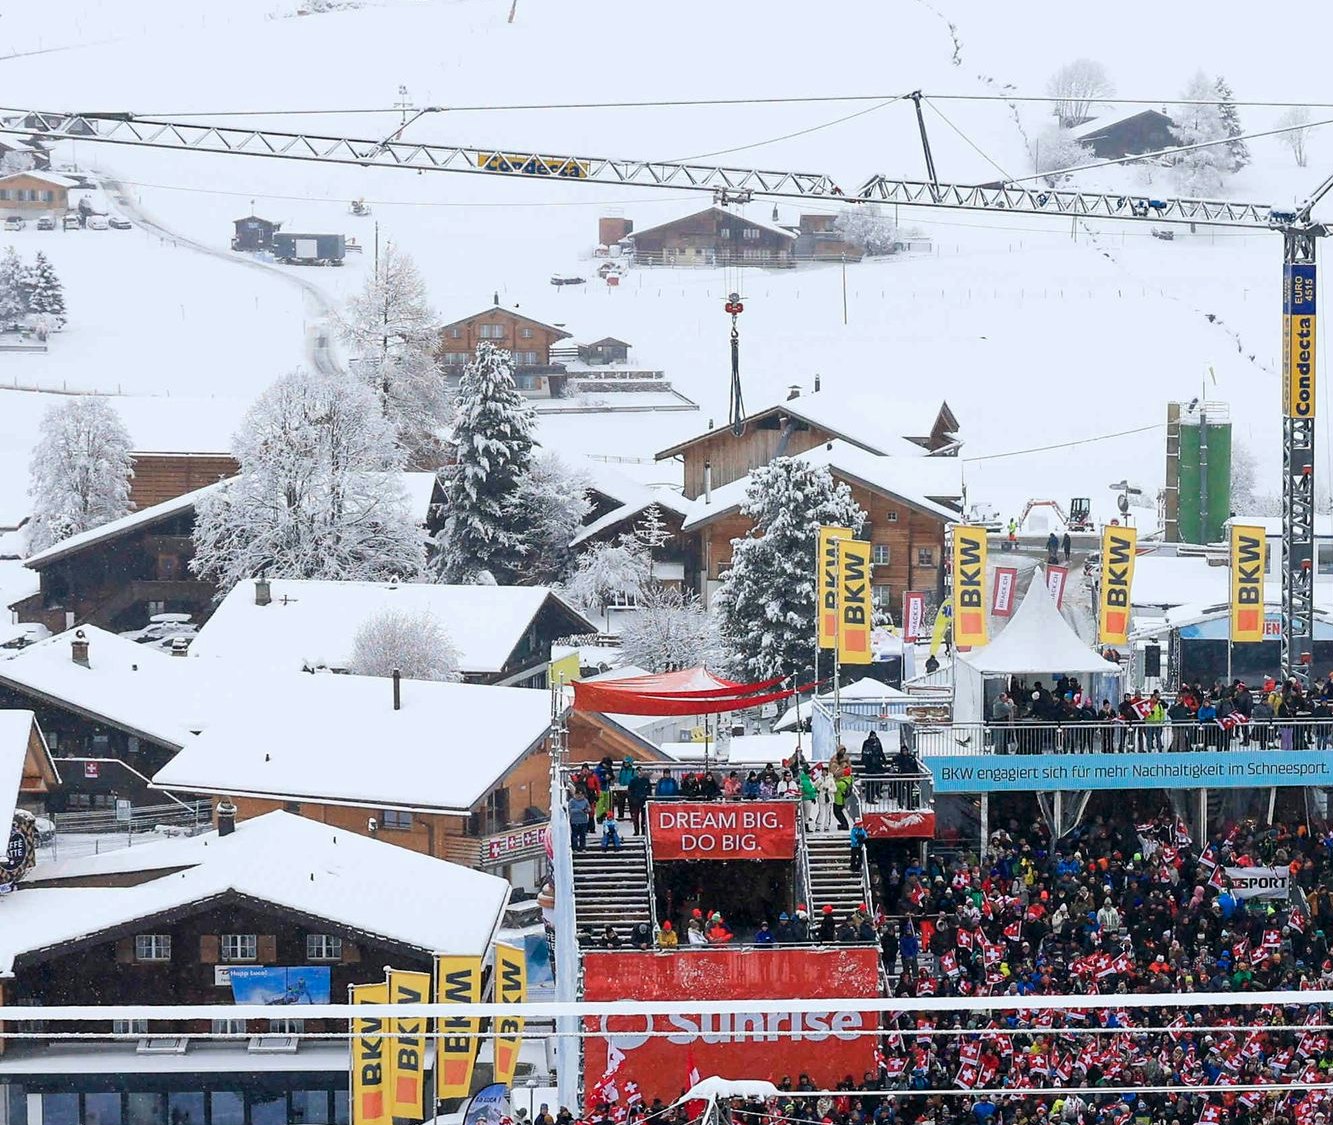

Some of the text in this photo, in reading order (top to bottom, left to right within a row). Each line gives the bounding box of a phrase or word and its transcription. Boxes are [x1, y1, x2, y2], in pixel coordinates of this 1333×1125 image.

[1294, 276, 1303, 305] EURO
[1304, 278, 1313, 302] 4515
[1295, 317, 1311, 416] Condecta
[960, 537, 981, 607] BKW
[1107, 535, 1130, 607] BKW
[1238, 535, 1261, 605] BKW
[844, 552, 866, 625] BKW
[942, 761, 1330, 781] BKW engagiert sich für mehr Nachhaltigkeit im Schneesport.
[659, 812, 783, 828] DREAM BIG.
[681, 834, 762, 850] DO BIG.
[1241, 876, 1287, 889] SPORT
